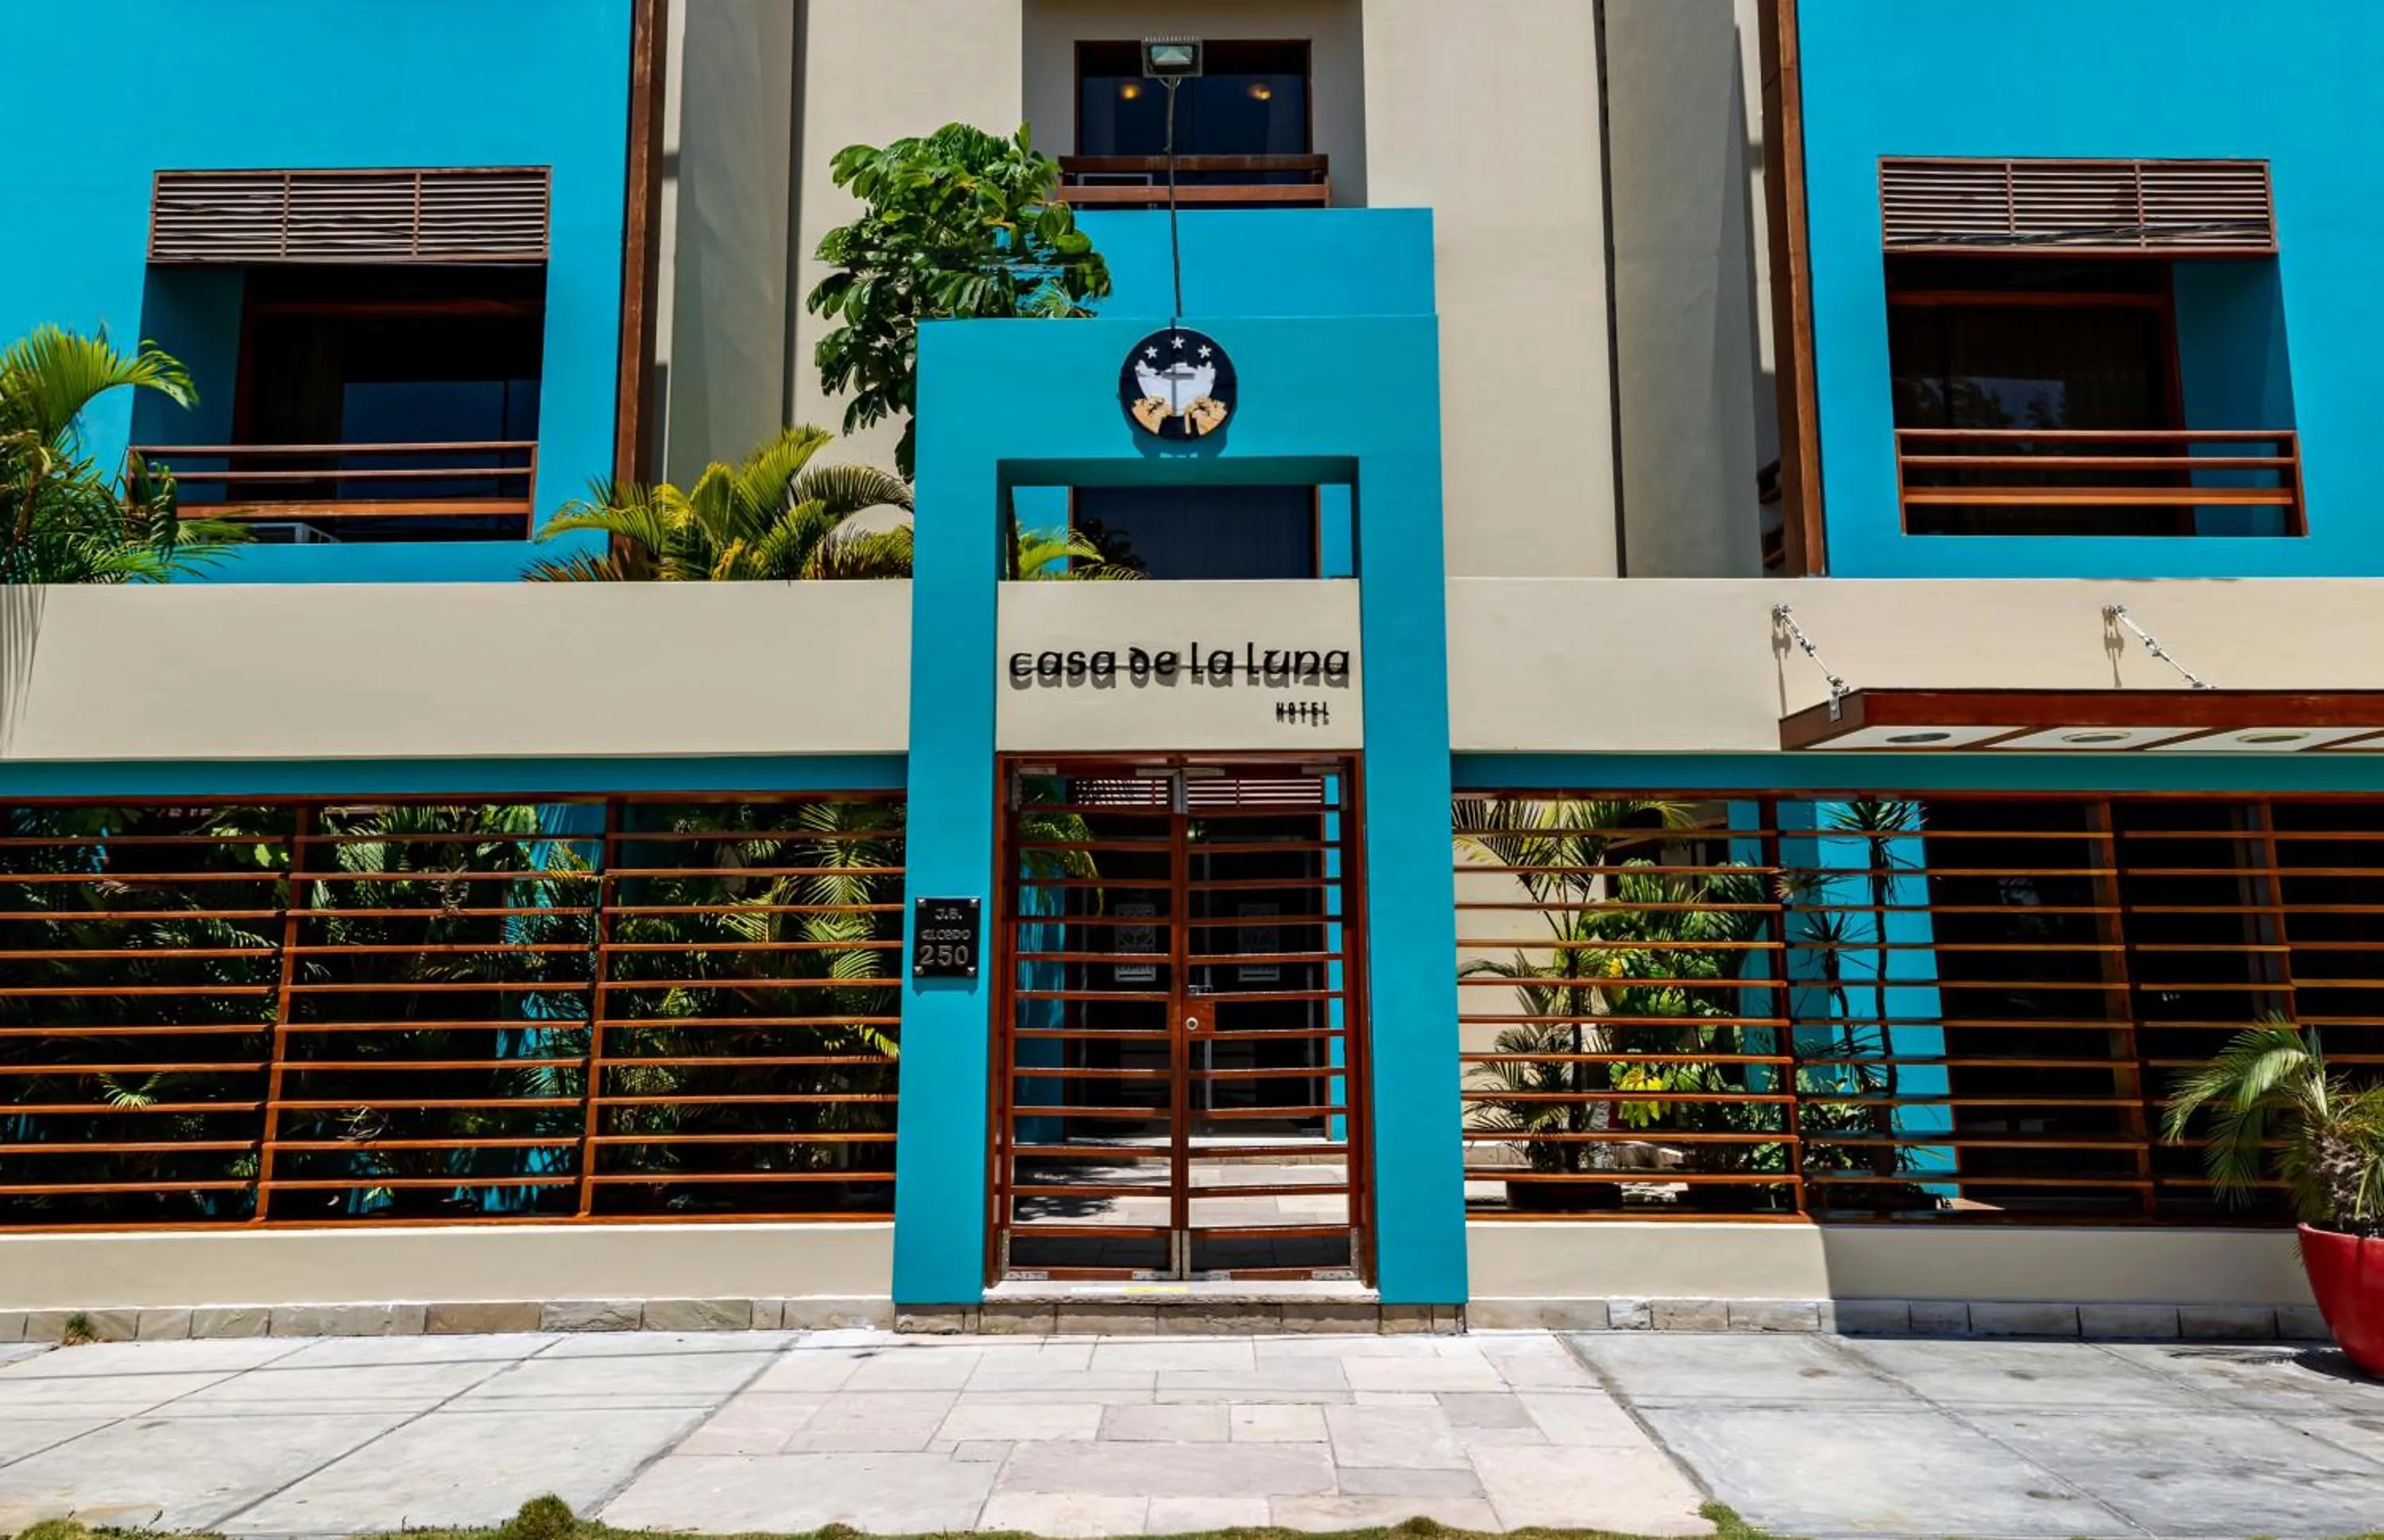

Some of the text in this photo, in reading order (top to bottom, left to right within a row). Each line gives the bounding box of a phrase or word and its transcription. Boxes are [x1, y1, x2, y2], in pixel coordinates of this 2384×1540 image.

[1009, 648, 1117, 676] casa
[1191, 641, 1234, 675] la
[1247, 641, 1350, 675] luna
[1275, 701, 1329, 717] HOTEL
[919, 944, 969, 967] 250
